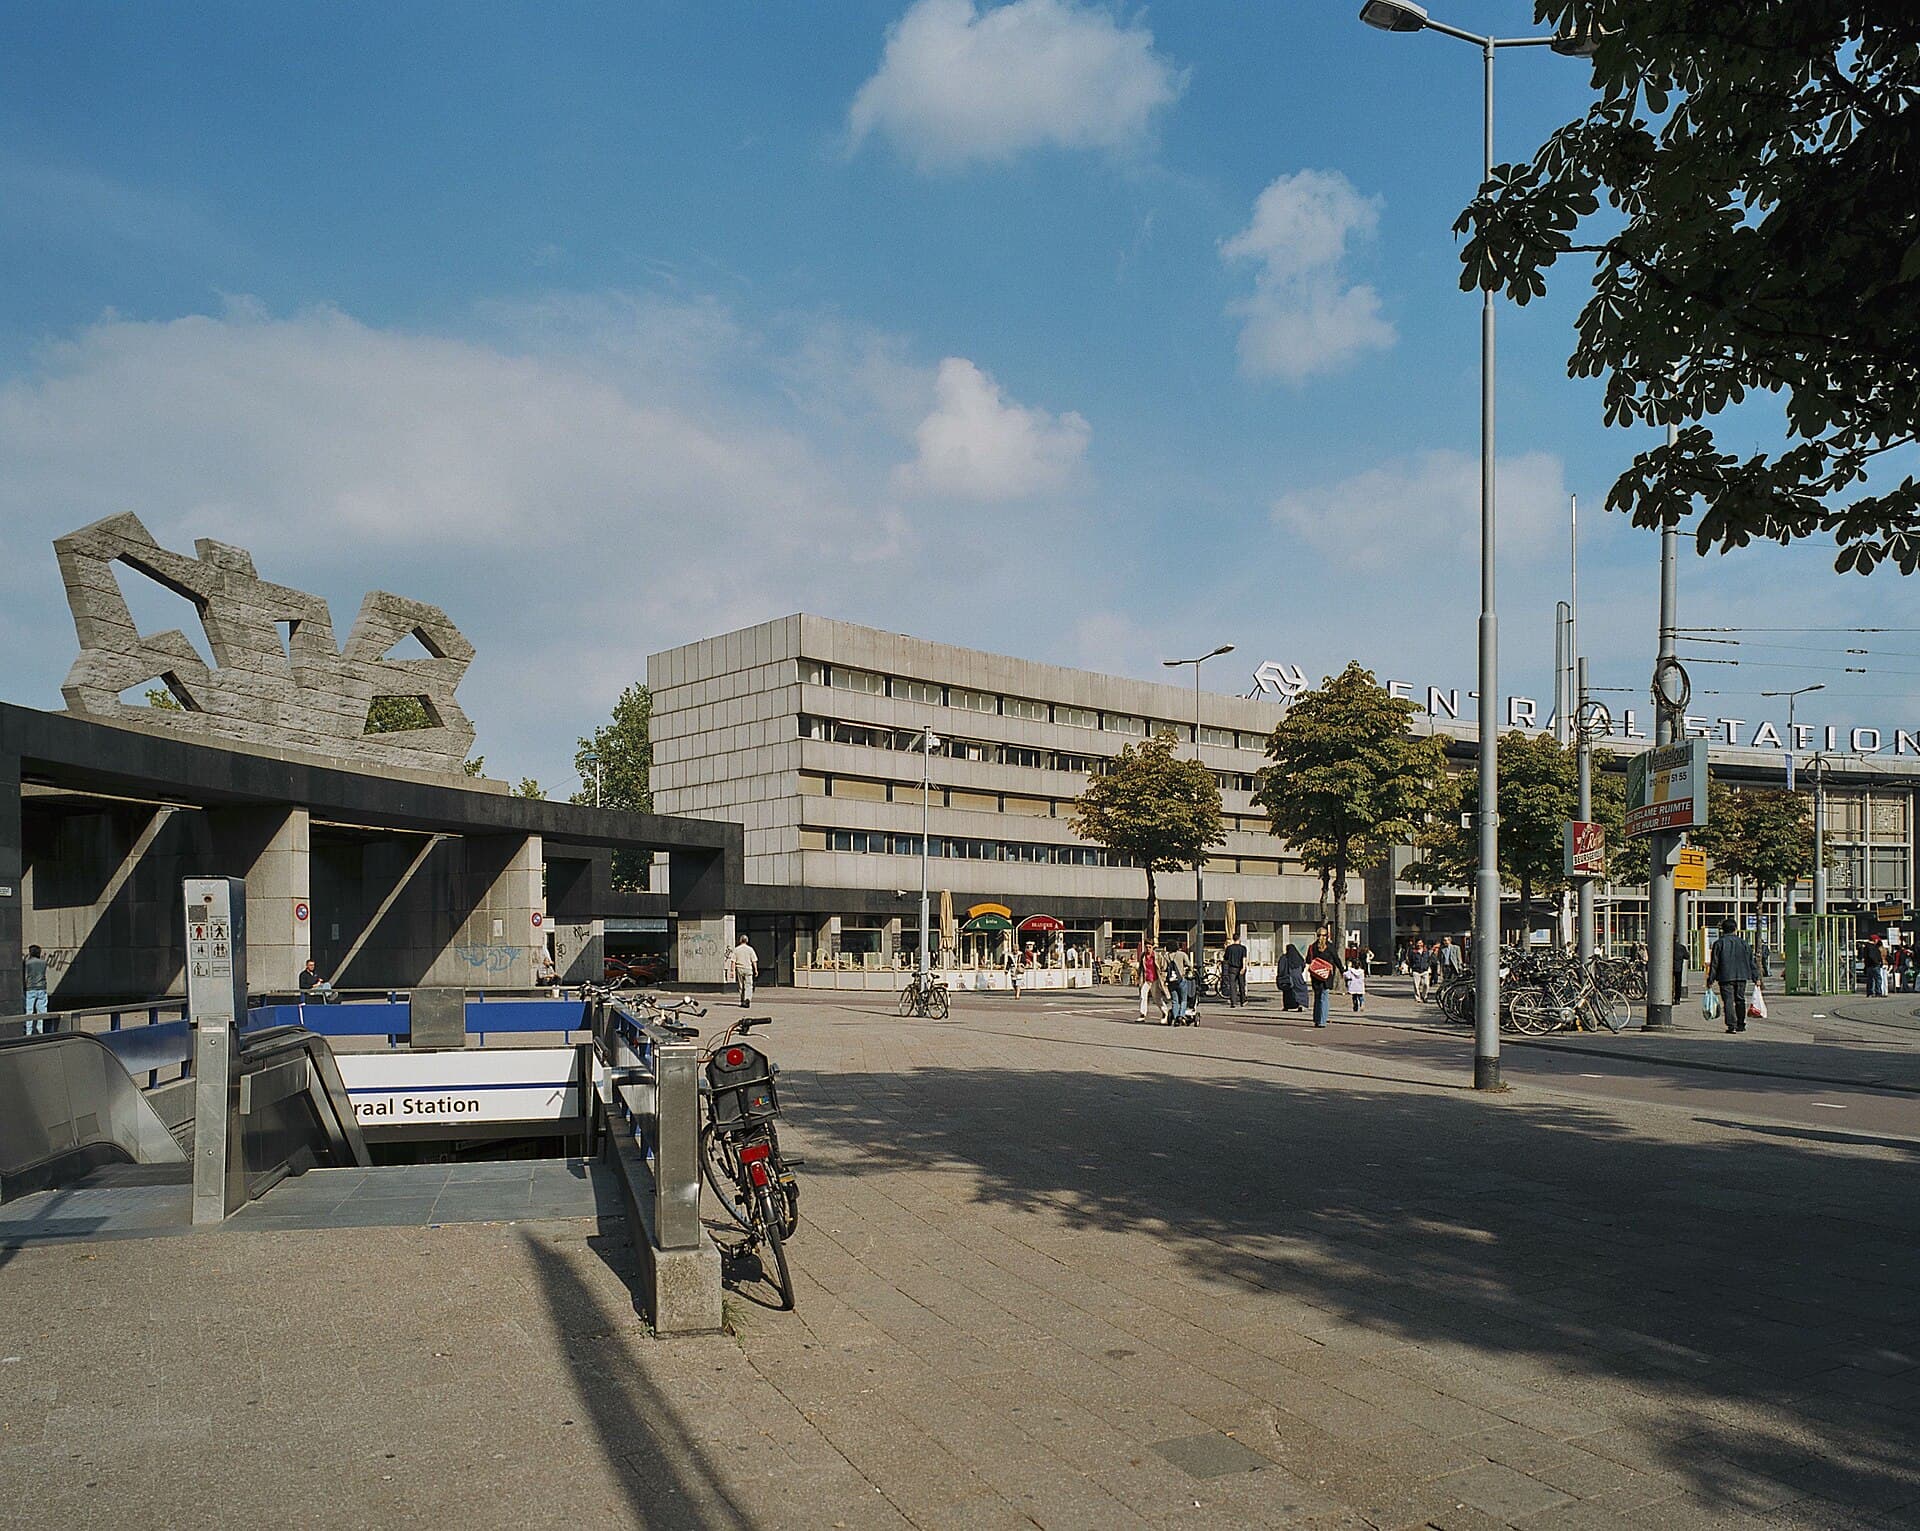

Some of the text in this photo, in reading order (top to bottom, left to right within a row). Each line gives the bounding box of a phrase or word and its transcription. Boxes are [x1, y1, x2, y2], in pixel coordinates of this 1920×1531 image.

[1684, 714, 1920, 755] STATION
[1659, 801, 1692, 814] RUIMTE
[1641, 818, 1659, 829] HUUR
[402, 1096, 479, 1115] Station
